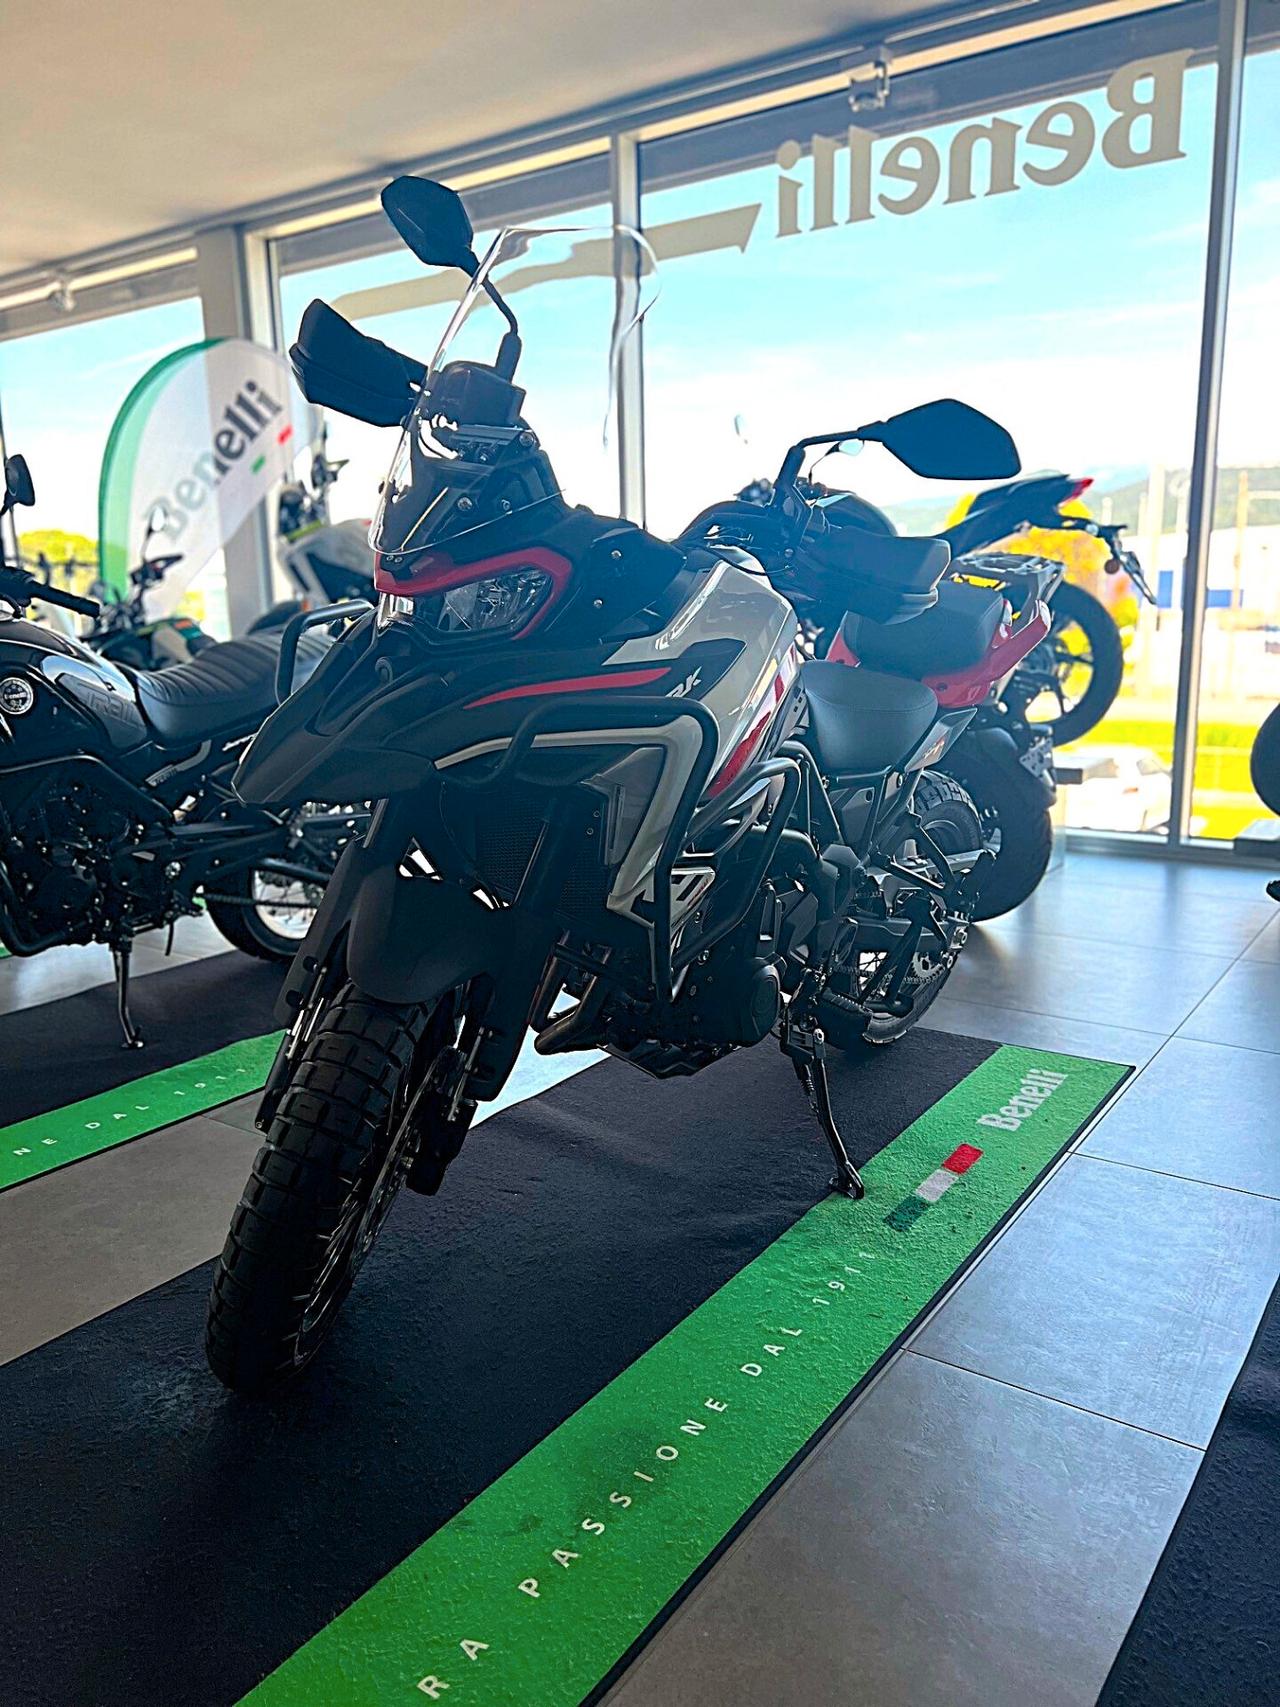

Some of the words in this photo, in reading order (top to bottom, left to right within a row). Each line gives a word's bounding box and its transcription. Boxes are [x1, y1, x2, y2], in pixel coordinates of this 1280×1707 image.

[145, 380, 283, 541] Benelli
[667, 666, 702, 698] RK
[84, 1104, 149, 1131] DAL
[976, 1068, 1068, 1132] Benelli
[517, 1397, 729, 1598] PASSIONE
[739, 1326, 803, 1377] DAL
